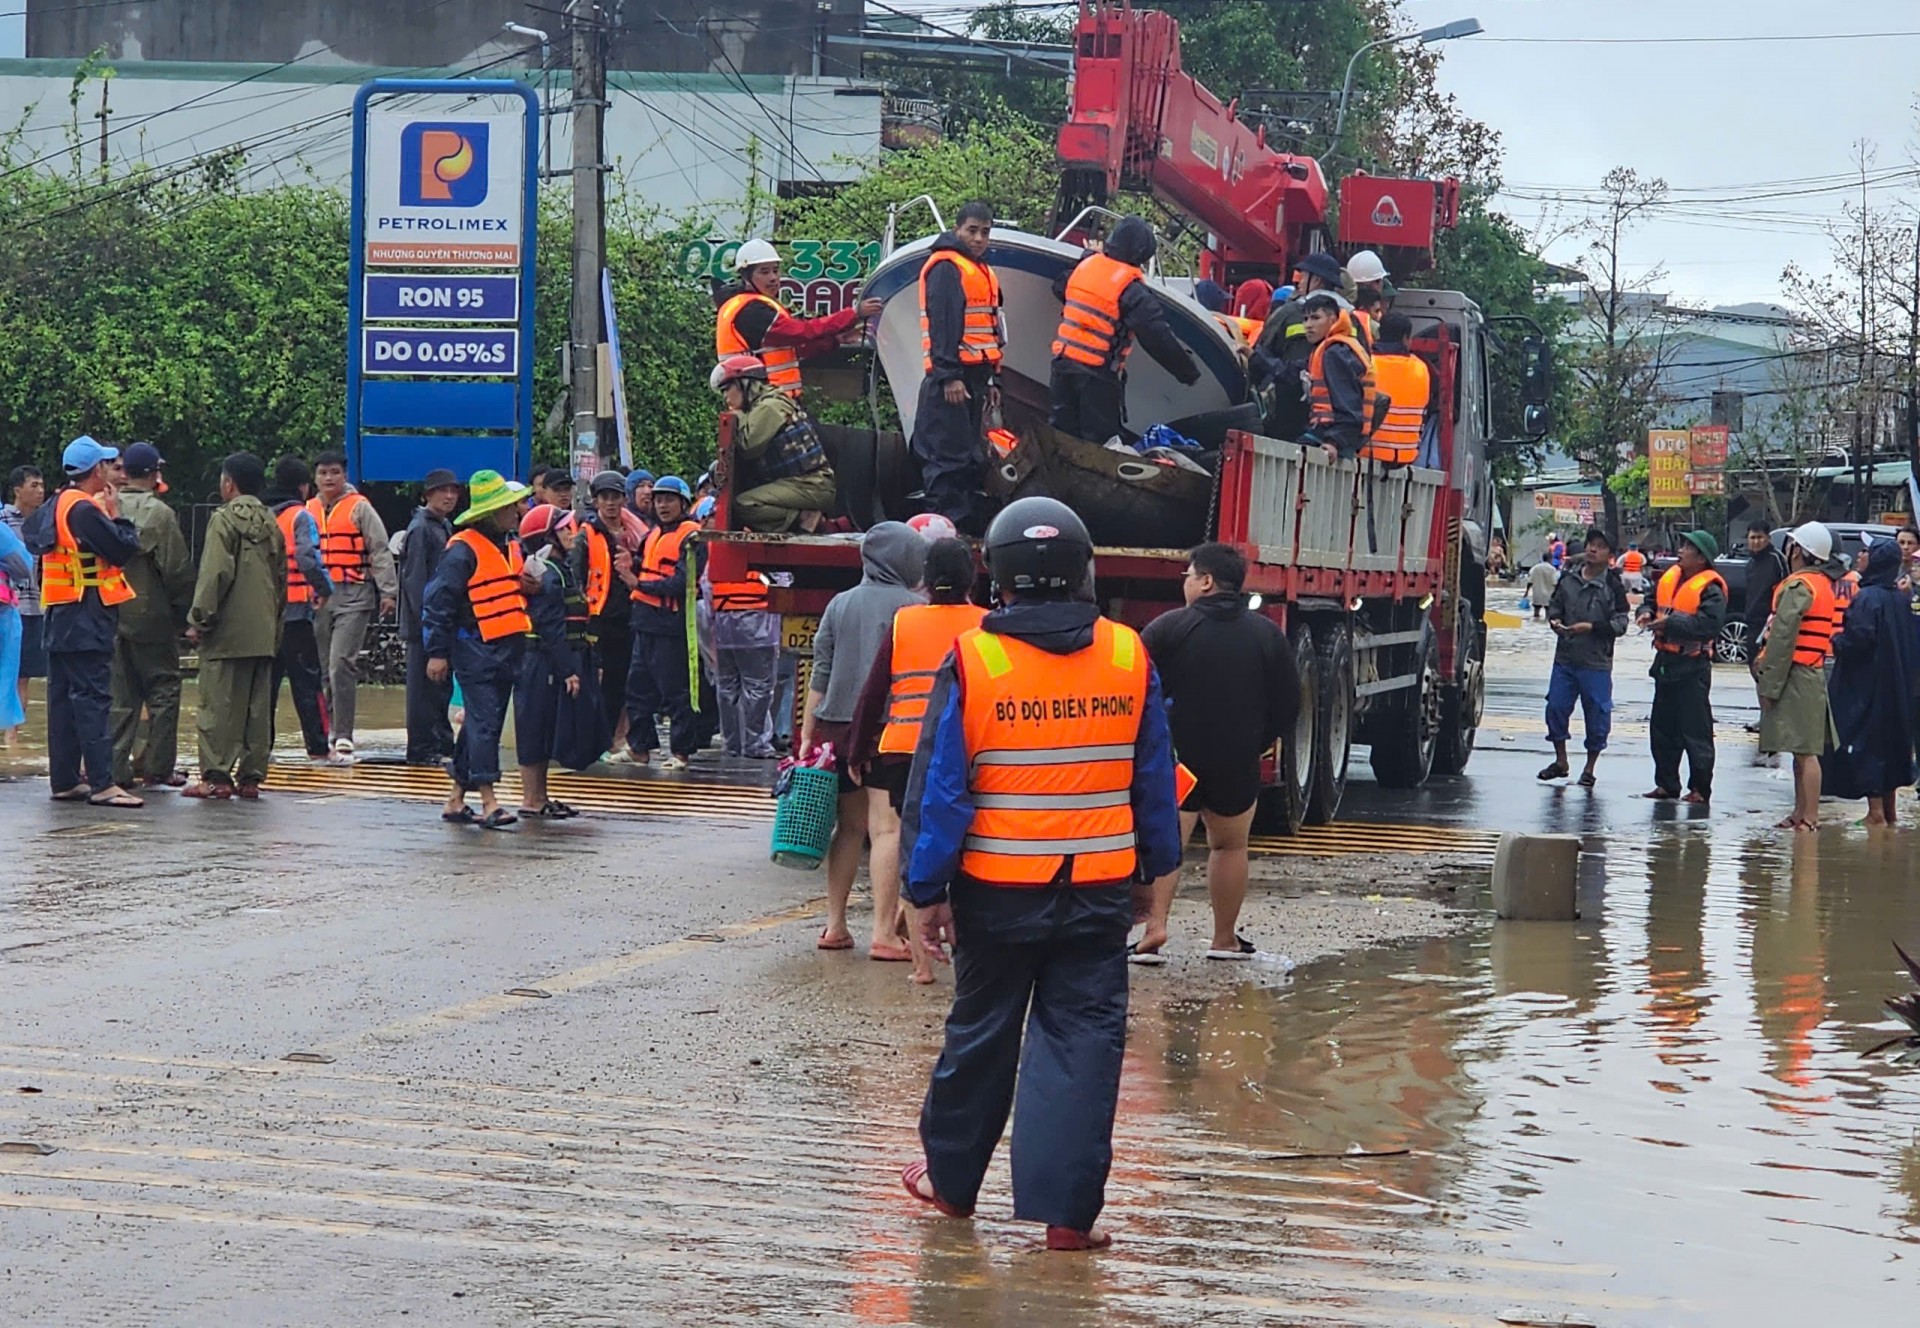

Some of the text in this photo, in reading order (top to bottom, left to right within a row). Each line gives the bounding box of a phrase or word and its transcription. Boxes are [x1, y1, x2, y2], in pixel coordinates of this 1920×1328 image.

[378, 217, 508, 231] PETROLIMEX
[399, 287, 484, 308] RON 95
[375, 341, 506, 363] DO 0.05%S
[996, 695, 1016, 728] BỘ
[1021, 696, 1048, 728] ĐỘI
